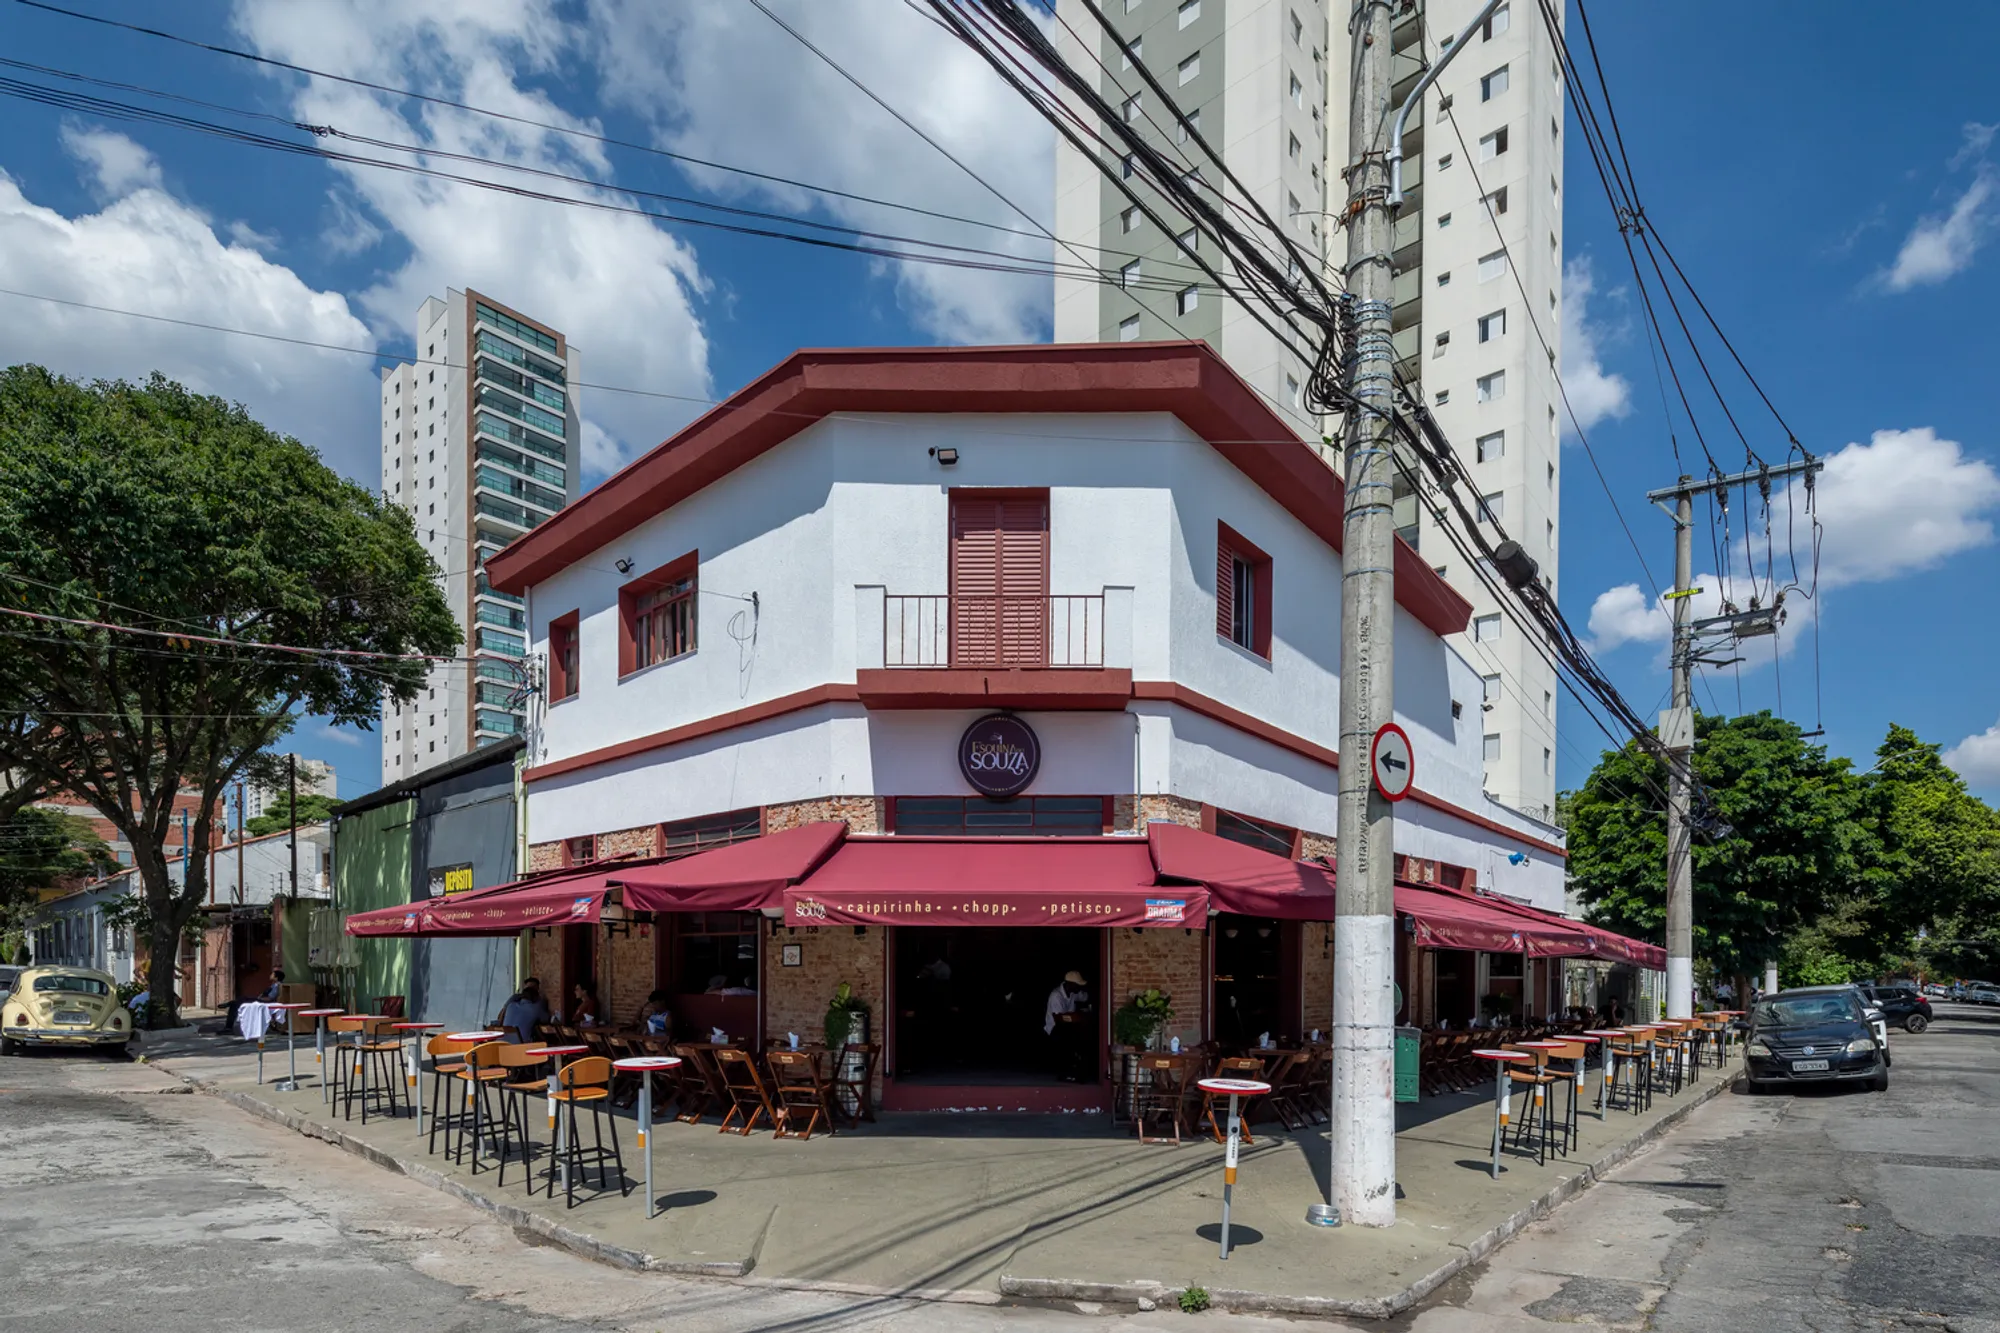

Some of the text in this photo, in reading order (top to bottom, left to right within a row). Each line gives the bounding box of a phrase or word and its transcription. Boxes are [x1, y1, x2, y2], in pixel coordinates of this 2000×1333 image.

[970, 752, 1029, 775] SOUZA
[847, 900, 932, 916] caipirinha
[962, 900, 1009, 916] chopp
[1050, 901, 1112, 916] petisco
